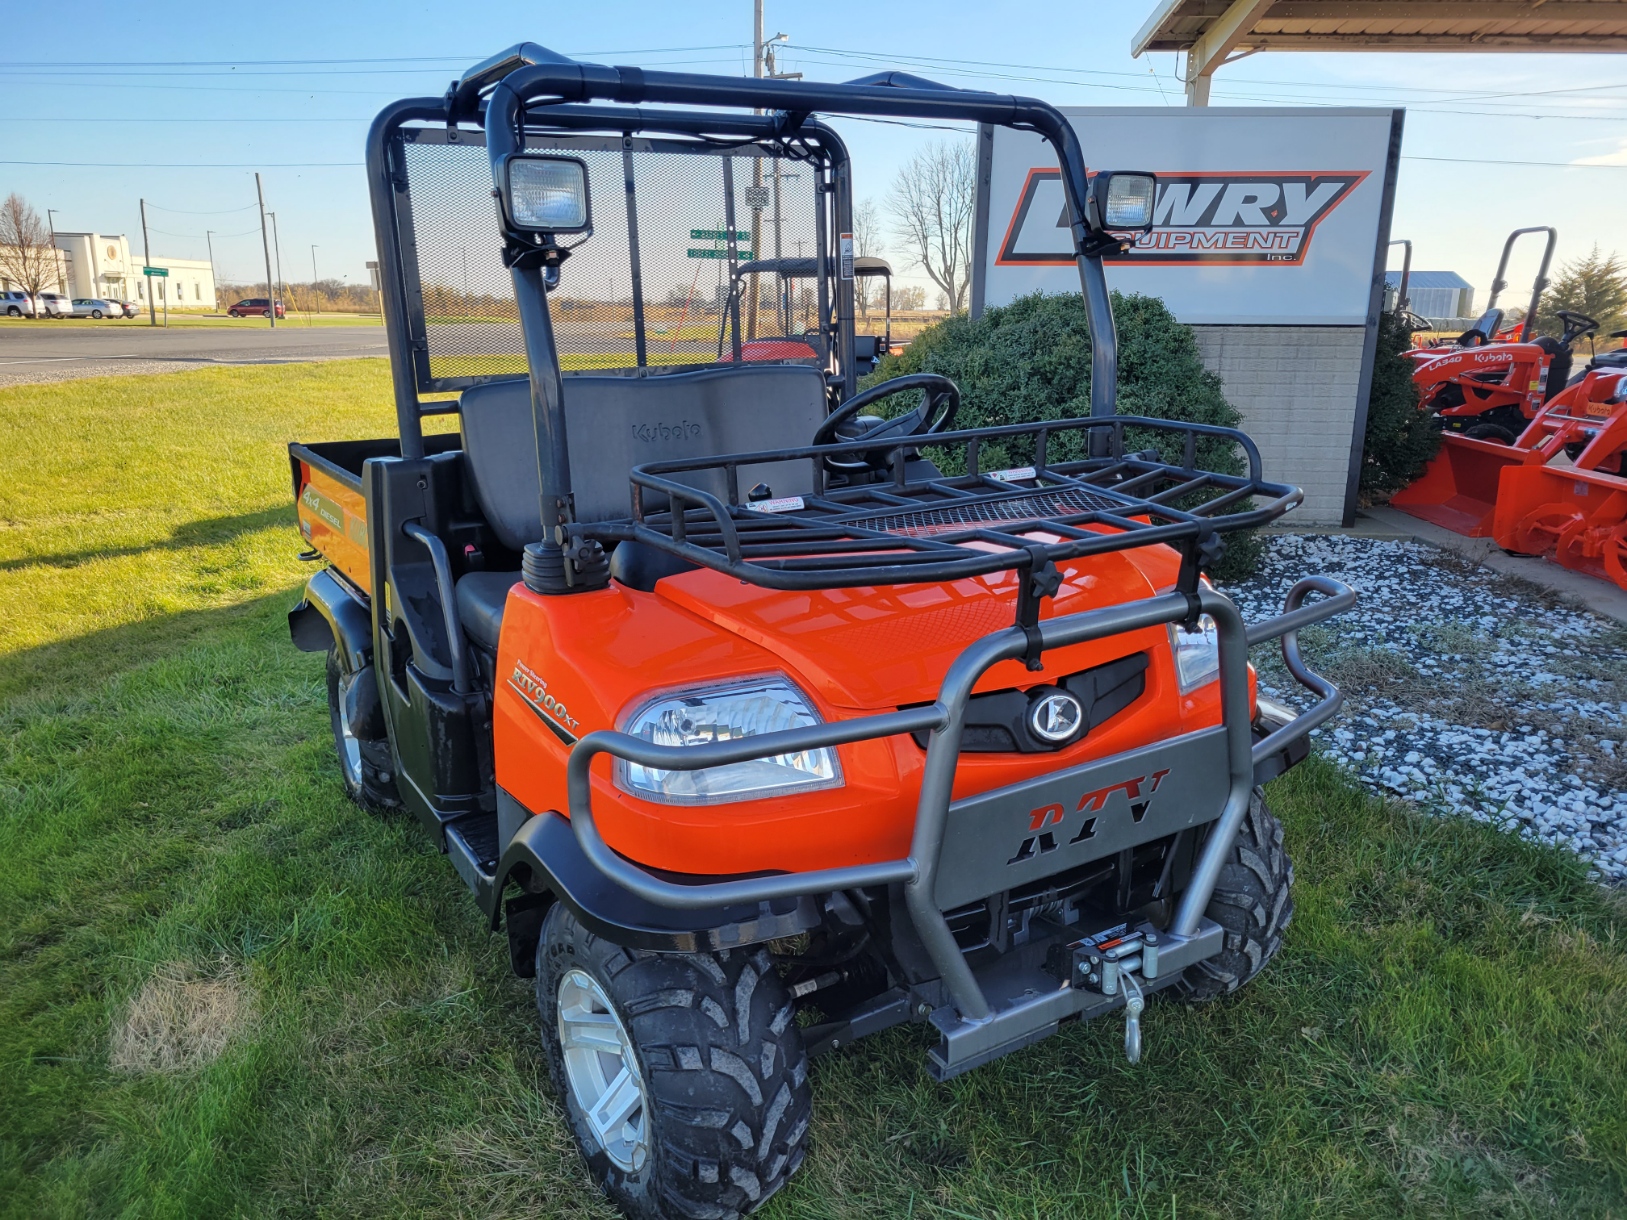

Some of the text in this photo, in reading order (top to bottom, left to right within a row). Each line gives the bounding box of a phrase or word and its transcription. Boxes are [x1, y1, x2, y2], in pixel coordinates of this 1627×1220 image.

[1012, 179, 1346, 254] LWRY
[1266, 253, 1297, 261] Inc.
[1428, 355, 1463, 372] LA340
[1474, 352, 1513, 363] Kubota
[1588, 404, 1611, 416] Kubota
[631, 420, 701, 442] Kubota
[303, 491, 342, 529] 4x4 DIESEL
[1006, 767, 1172, 866] RTV
